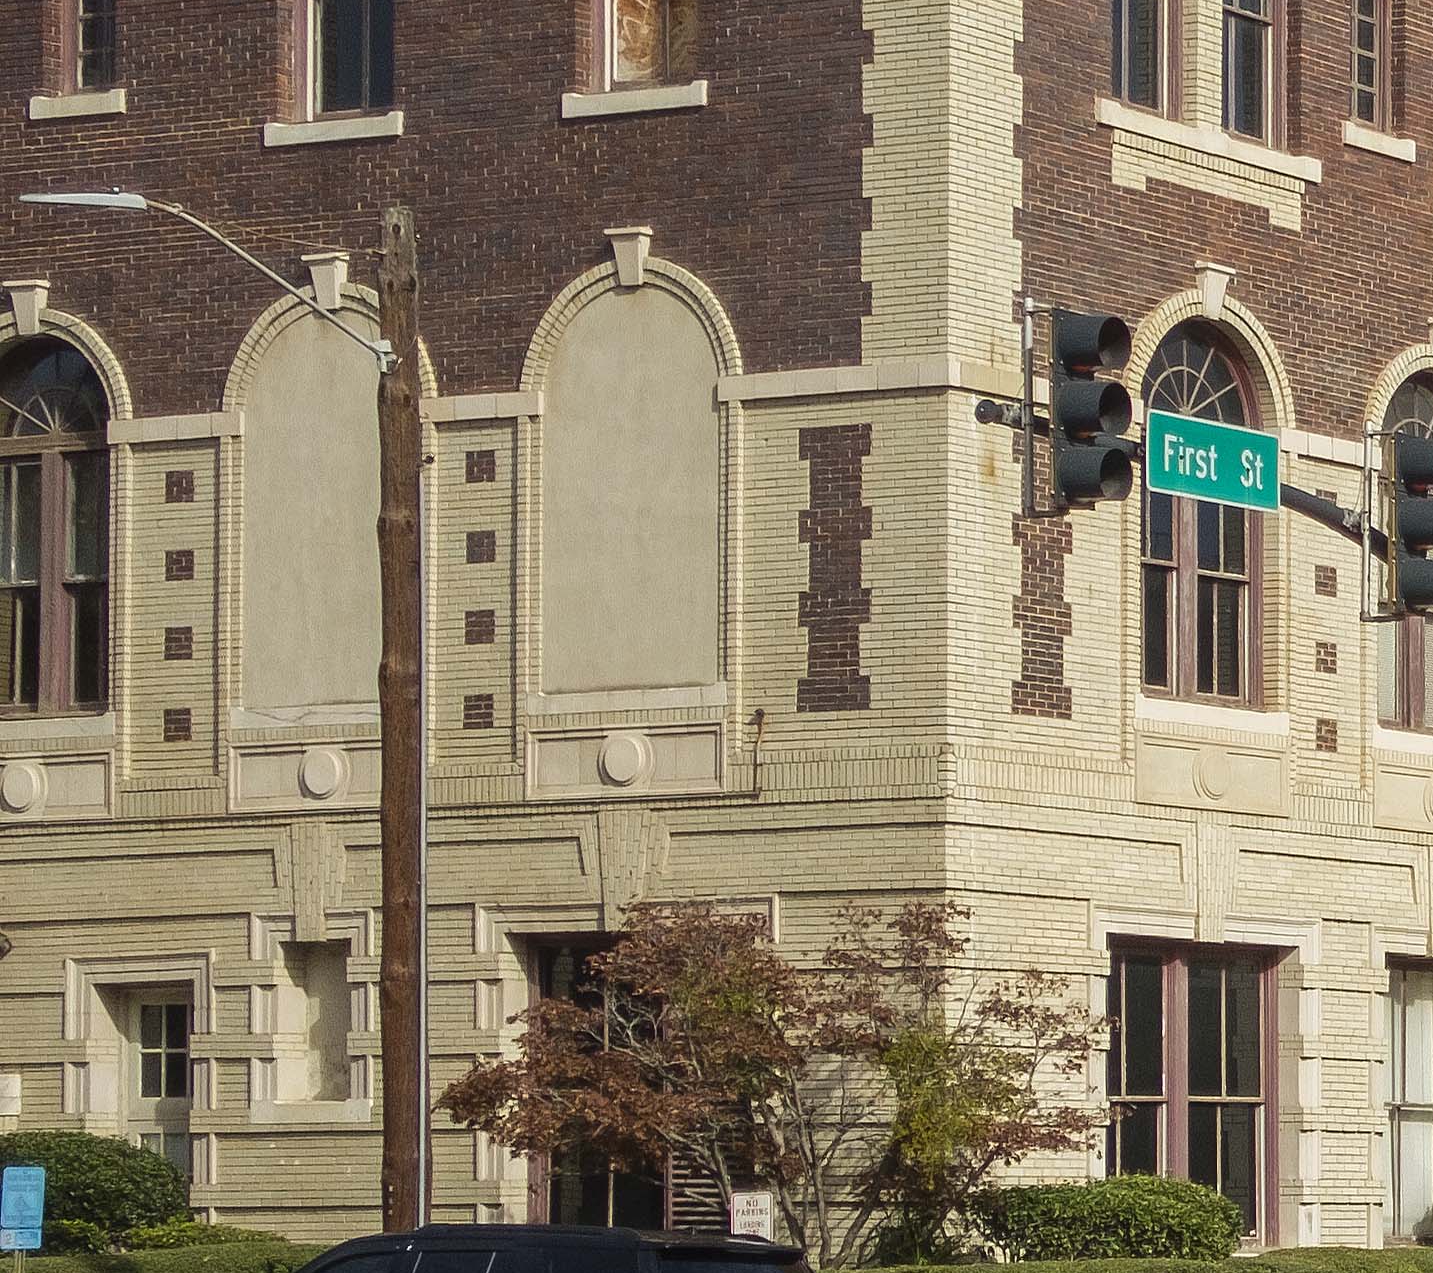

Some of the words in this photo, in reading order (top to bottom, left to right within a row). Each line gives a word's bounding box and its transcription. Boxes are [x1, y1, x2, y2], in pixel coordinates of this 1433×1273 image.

[1164, 433, 1218, 481] First
[1240, 449, 1264, 490] St
[746, 1198, 759, 1207] NO
